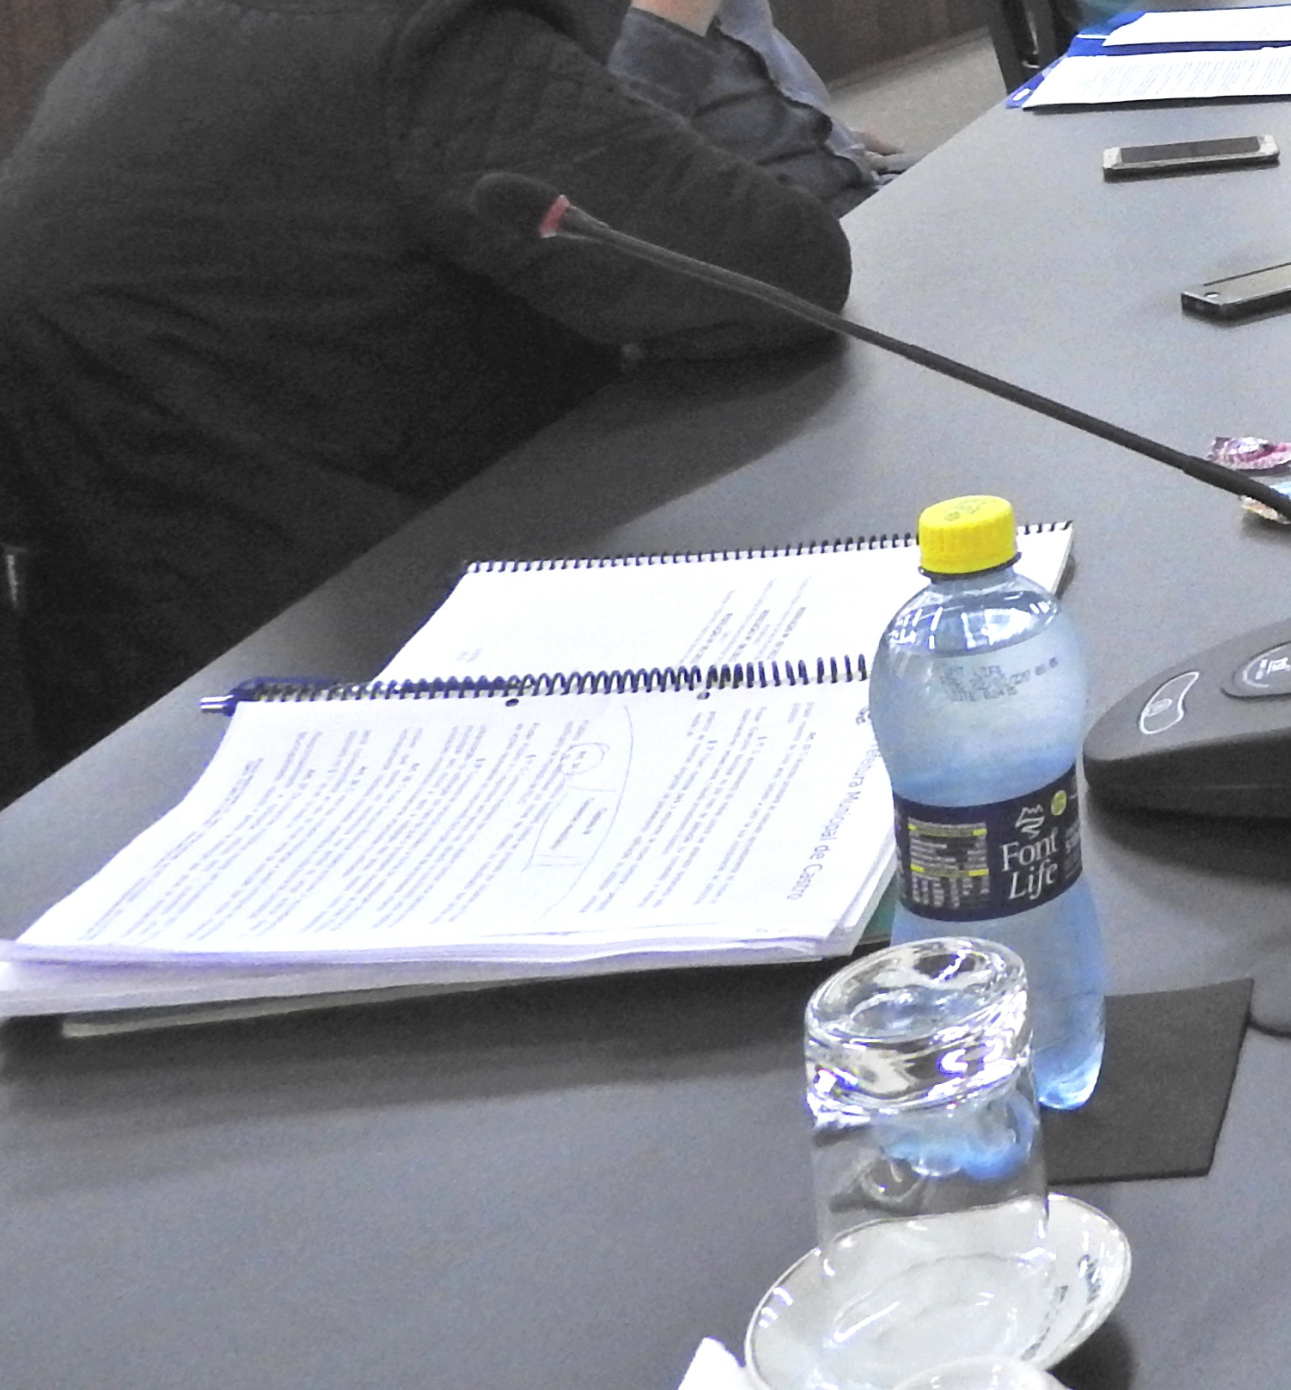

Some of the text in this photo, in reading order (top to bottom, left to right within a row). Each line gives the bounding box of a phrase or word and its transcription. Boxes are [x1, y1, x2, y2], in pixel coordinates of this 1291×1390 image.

[819, 791, 861, 841] Municipal
[809, 845, 830, 860] de
[1001, 827, 1059, 872] Font
[786, 863, 823, 900] Castro
[1009, 858, 1058, 900] Life
